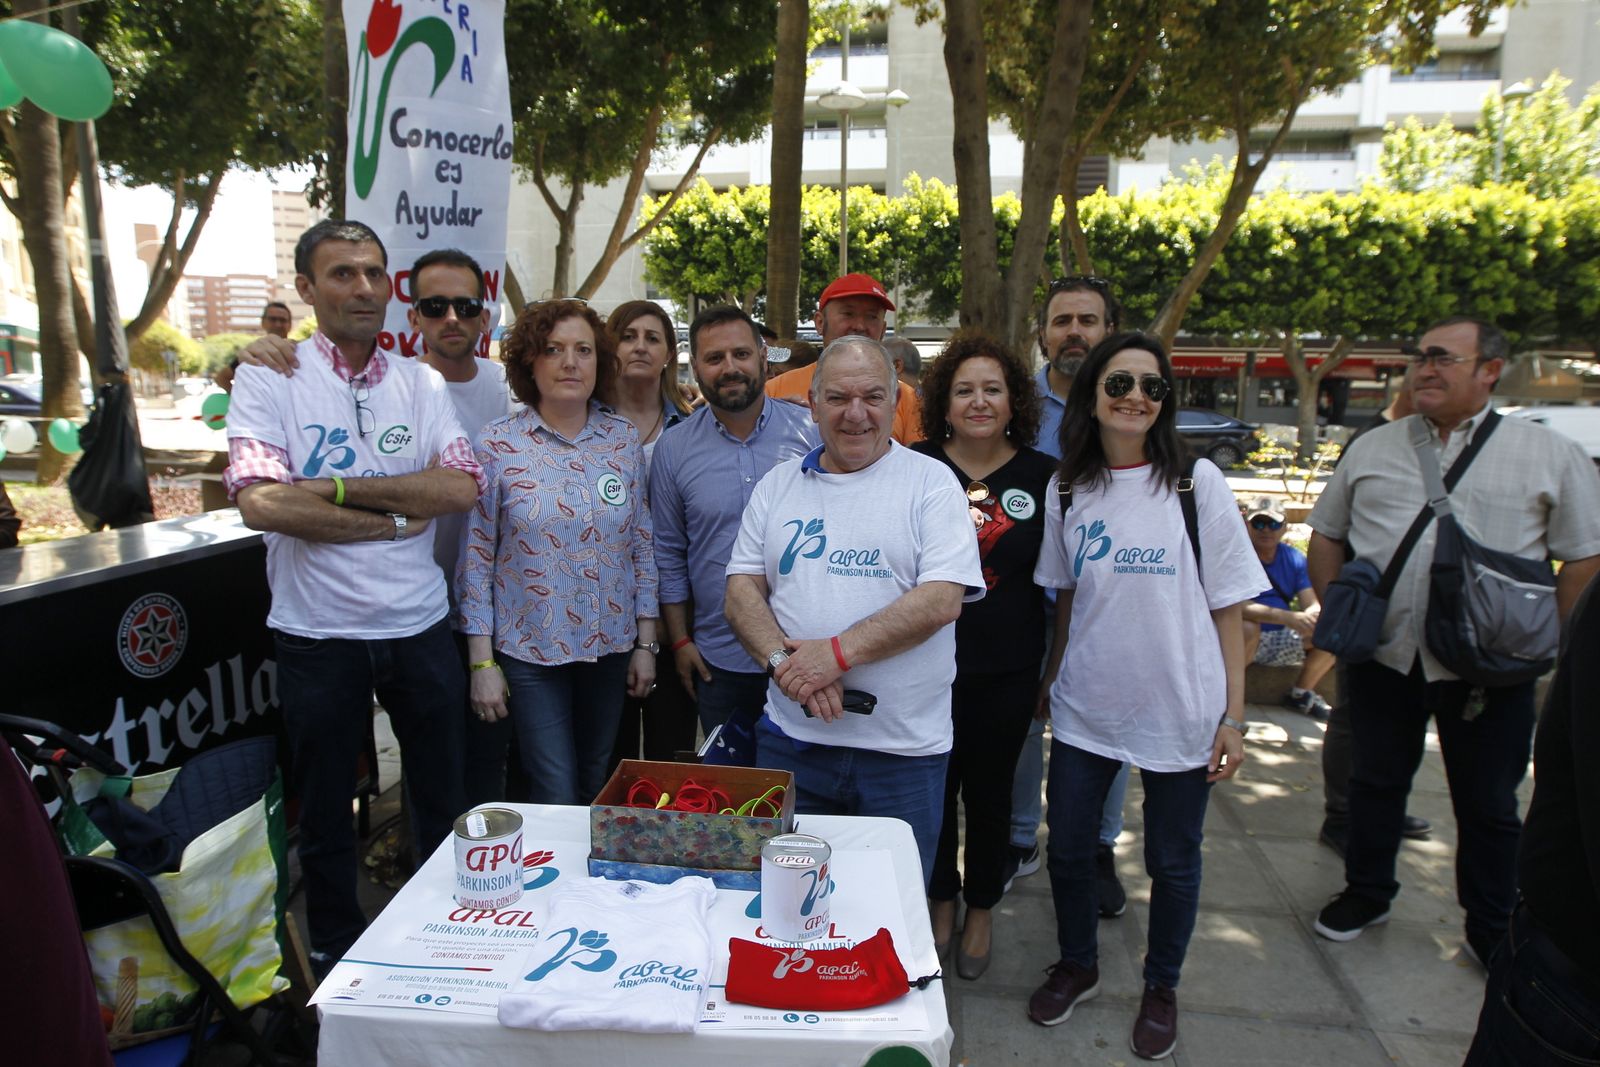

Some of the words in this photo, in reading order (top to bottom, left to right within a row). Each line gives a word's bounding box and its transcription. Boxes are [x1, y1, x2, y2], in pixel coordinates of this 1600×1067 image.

[389, 107, 512, 160] Conocerlo
[435, 159, 463, 184] es
[395, 190, 483, 240] Ayudar
[826, 566, 863, 577] PARKINSON
[1113, 566, 1148, 575] PARKINSON
[457, 871, 511, 891] PARKINSON
[422, 922, 488, 937] PARKINSON
[489, 927, 539, 939] ALMERÍA
[431, 952, 472, 960] CONTAMOS
[473, 953, 505, 961] CONTIGO
[432, 976, 475, 986] PARKINSON
[613, 975, 669, 989] PARKINSON
[670, 980, 703, 992] ALMER
